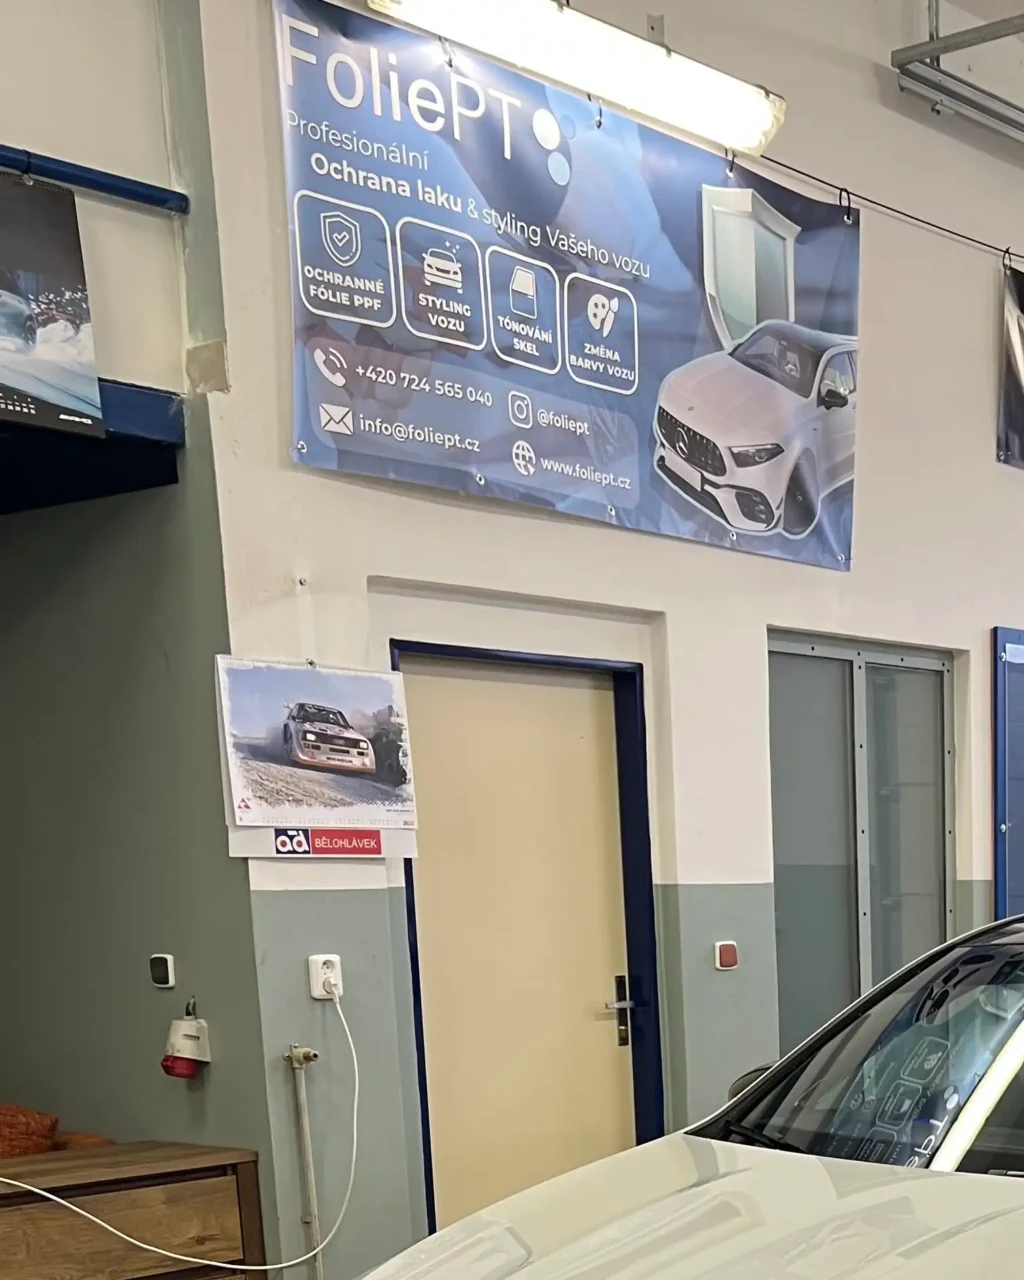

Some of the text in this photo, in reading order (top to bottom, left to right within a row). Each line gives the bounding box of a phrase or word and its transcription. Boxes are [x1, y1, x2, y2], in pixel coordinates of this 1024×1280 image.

[281, 13, 522, 160] FoliePT
[286, 109, 430, 171] Profesionální
[310, 152, 651, 278] Ochrana laku & styling Vašeho vozu
[303, 265, 385, 294] OCHRANNÉ
[309, 281, 382, 311] FÓLIE PPF
[418, 293, 471, 317] STYLING
[428, 313, 465, 332] VOZU
[497, 315, 553, 343] TÓNOVÁNÍ
[513, 337, 540, 356] SKEL
[583, 343, 621, 362] ZMĚNA
[569, 354, 635, 381] BARVY VOZU
[355, 365, 493, 407] +420 724 565 040
[359, 414, 481, 452] info@foliept.cz
[537, 409, 590, 435] @foliept
[540, 457, 632, 490] www.foliept.cz
